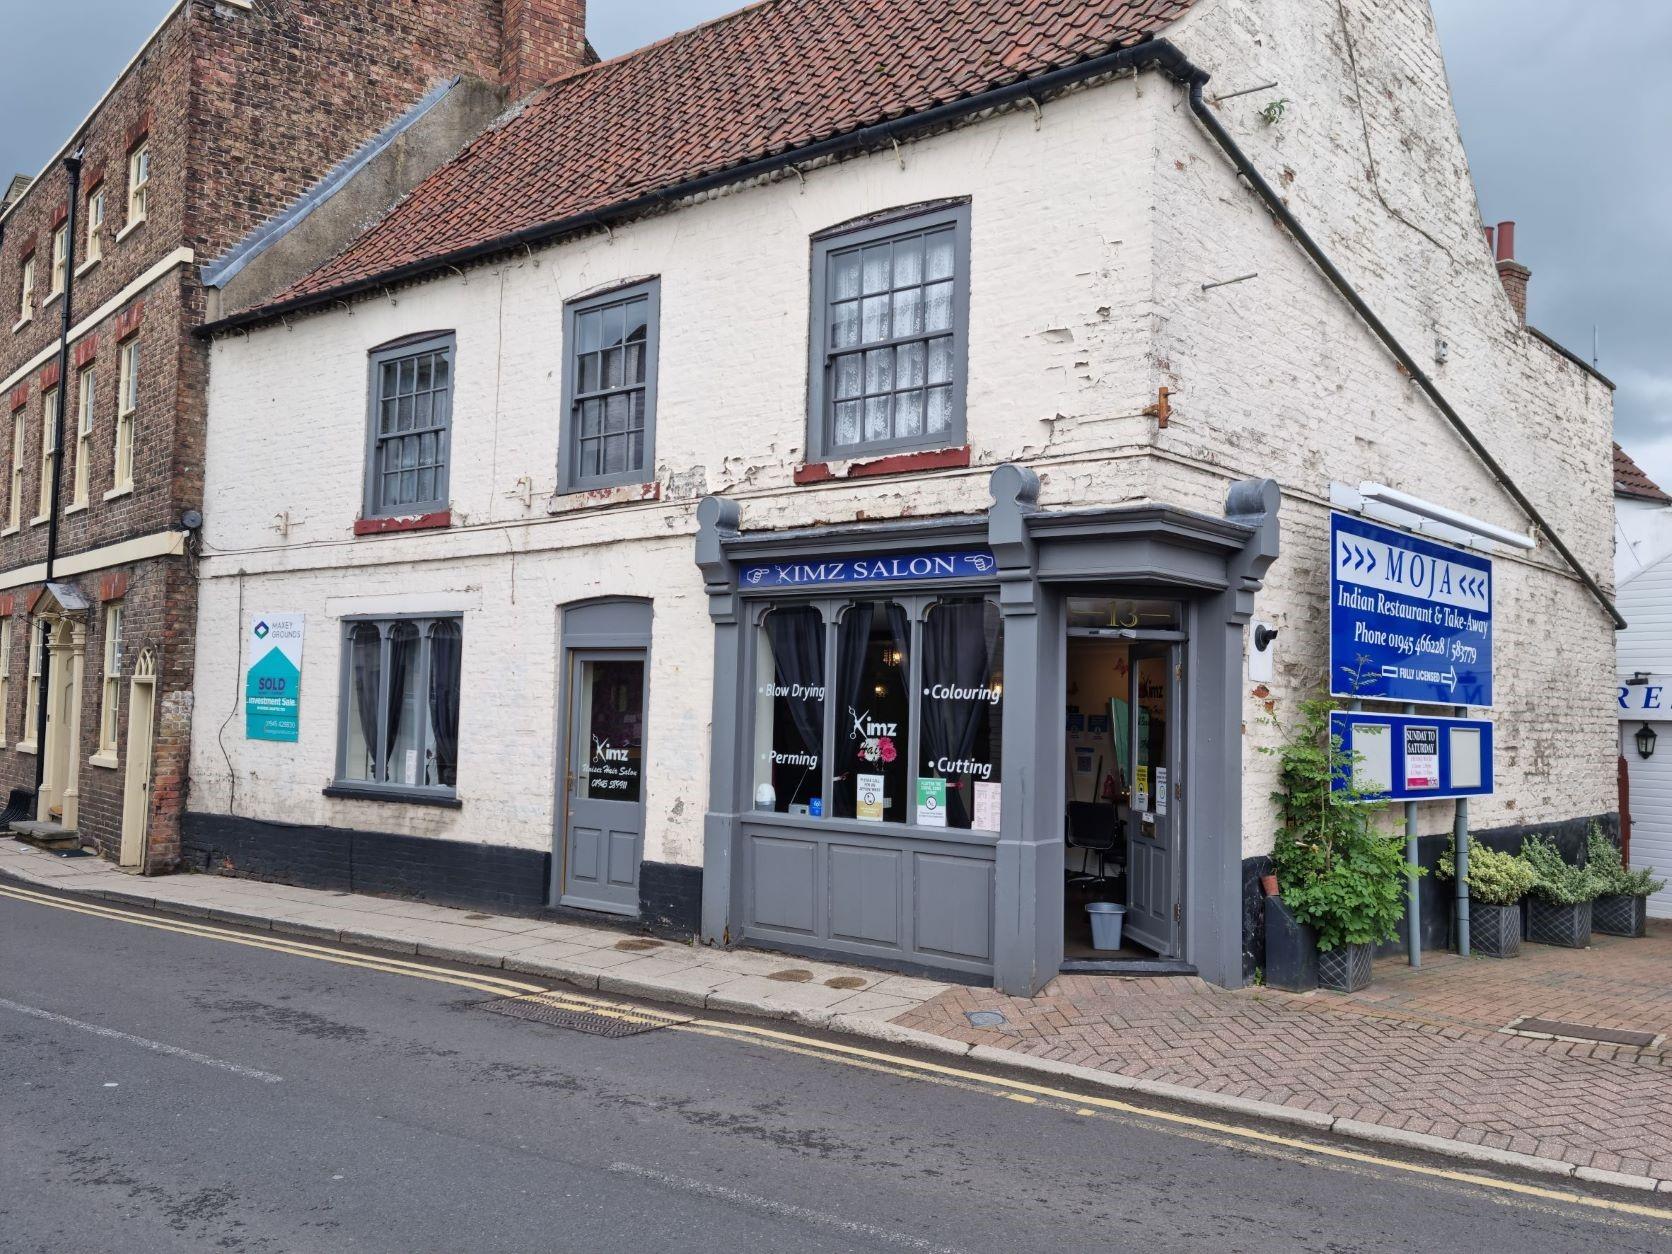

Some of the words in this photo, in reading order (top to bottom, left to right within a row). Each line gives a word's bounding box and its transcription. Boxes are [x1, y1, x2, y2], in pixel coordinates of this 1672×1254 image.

[775, 563, 845, 583] KIMZ
[853, 556, 956, 579] SALON
[1385, 547, 1452, 599] MOJA
[1107, 601, 1138, 628] 13
[1337, 584, 1374, 612] Indian
[1377, 592, 1432, 624] Restaurant
[1434, 605, 1442, 624] &
[1444, 607, 1489, 639] Take-Away
[271, 621, 293, 630] MAXEY
[271, 630, 301, 639] GROUNDS
[1354, 621, 1386, 646] Phone
[1388, 636, 1414, 655] 01945
[1415, 633, 1445, 656] 466228
[1451, 640, 1477, 664] 583779
[258, 677, 286, 691] SOLD
[1400, 668, 1414, 680] FULLY
[1415, 669, 1441, 683] LICENSED
[248, 697, 282, 705] Investment
[282, 698, 296, 706] Sale
[766, 683, 789, 697] Blow
[792, 683, 825, 701] Drying
[931, 684, 1001, 705] Colouring
[1617, 686, 1672, 709] RE
[849, 705, 898, 739] Kimz
[1406, 730, 1428, 741] SUNDAY
[1428, 731, 1436, 742] TO
[592, 733, 629, 763] Kimz
[1407, 743, 1435, 754] SATURDAY
[768, 750, 818, 770] Perming
[937, 757, 992, 779] Cutting
[619, 766, 638, 776] Salon
